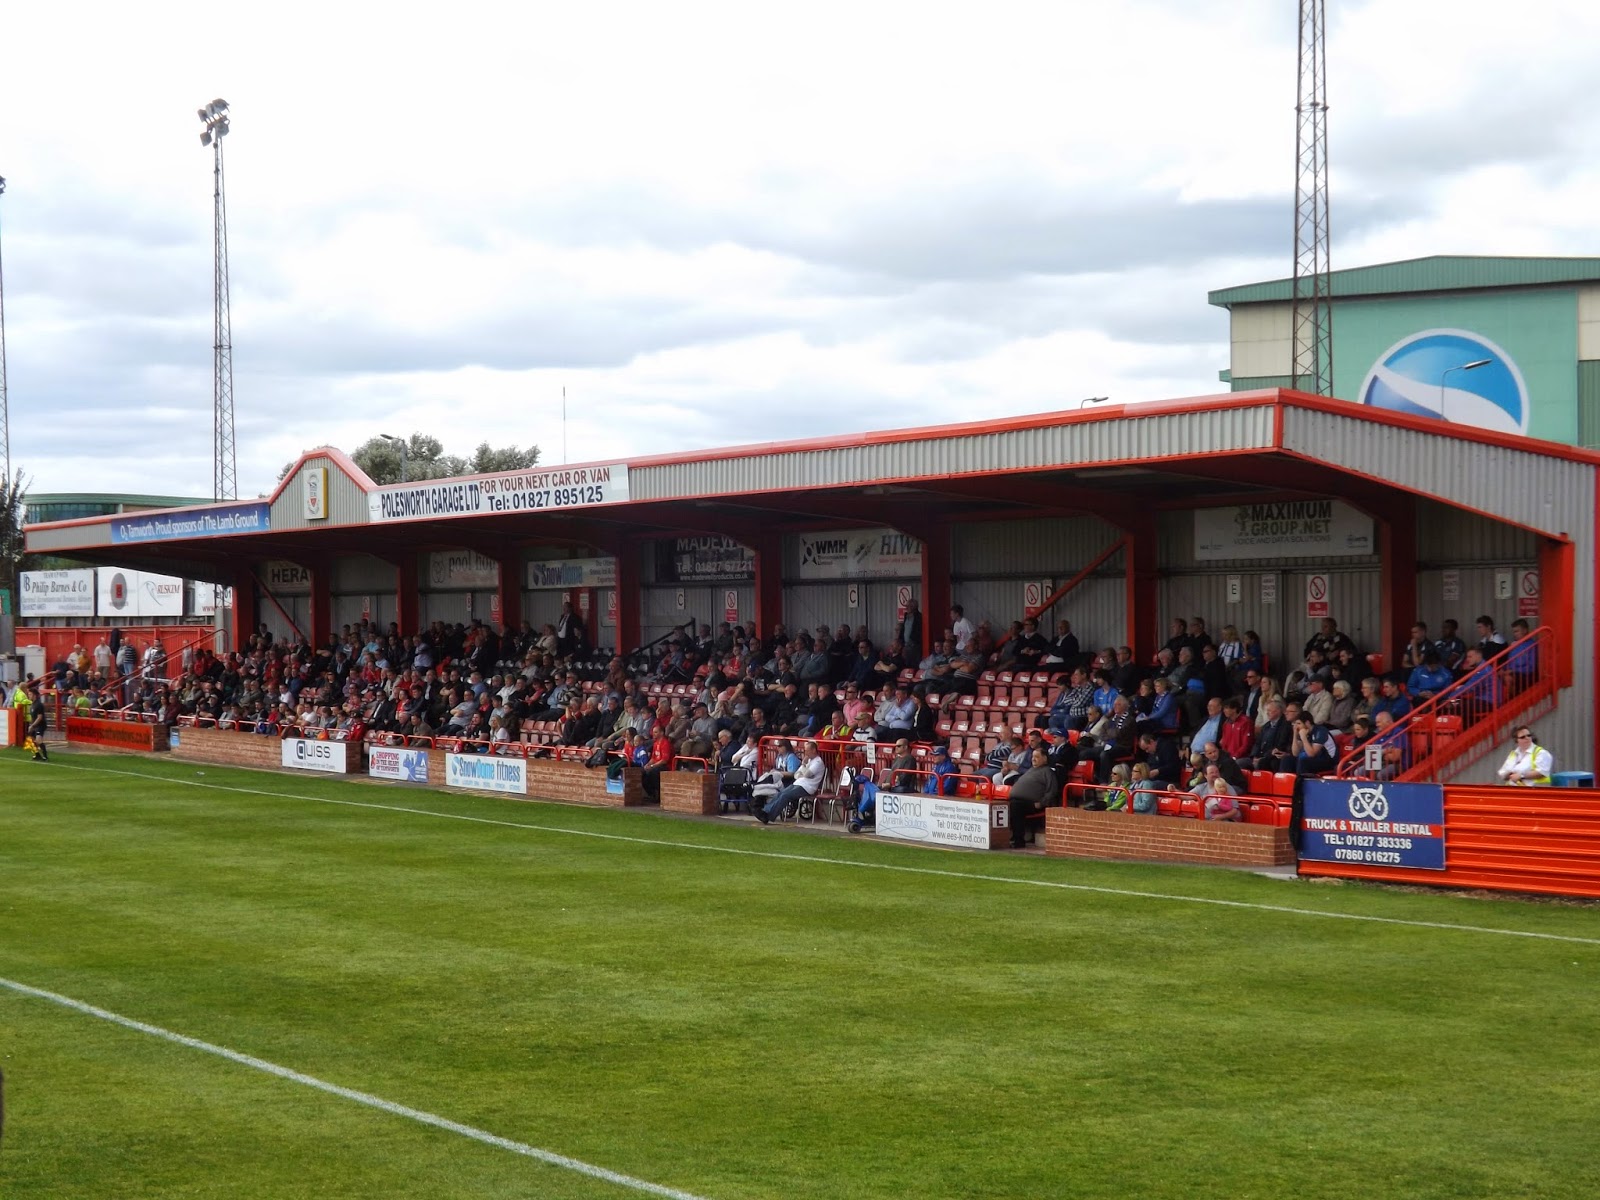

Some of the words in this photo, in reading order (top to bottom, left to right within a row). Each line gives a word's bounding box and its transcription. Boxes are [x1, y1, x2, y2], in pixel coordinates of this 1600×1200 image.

[480, 480, 496, 494] FOR
[498, 477, 524, 492] YOUR
[526, 474, 550, 490] NEXT
[552, 472, 570, 487] CAR
[573, 470, 587, 484] OR
[590, 467, 610, 483] VAN
[381, 488, 430, 518] POLESWORTH
[432, 485, 464, 514] GARAGE
[464, 484, 480, 510] LTD
[488, 494, 510, 511] Tel:
[512, 490, 550, 510] 01827
[554, 486, 603, 504] 895125
[1252, 501, 1332, 521] MAXIMUM
[156, 519, 172, 535] Proud
[172, 521, 198, 536] sponsors
[198, 516, 204, 530] of
[205, 516, 216, 529] The
[217, 514, 233, 530] Lamb
[234, 510, 259, 528] Ground
[1251, 519, 1331, 536] GROUP.NET
[816, 540, 848, 554] WMH
[1271, 536, 1289, 544] DATA
[449, 550, 471, 578] pool
[676, 562, 692, 573] Tel:
[50, 581, 70, 592] Barnes
[72, 581, 76, 592] &
[78, 580, 87, 592] Co
[1232, 584, 1236, 594] E
[1500, 580, 1506, 596] F
[678, 593, 684, 606] C
[849, 590, 857, 604] C
[376, 751, 399, 762] SHOPPING
[1369, 751, 1378, 769] F
[459, 756, 494, 780] SnowDome
[496, 759, 520, 783] fitness
[934, 804, 956, 814] Engineering
[956, 806, 971, 814] Services
[904, 816, 928, 828] Solutions
[930, 811, 949, 819] Automotive
[956, 814, 970, 822] Railway
[996, 810, 1004, 826] E
[946, 820, 963, 831] 01827
[964, 822, 981, 832] 62678
[1305, 818, 1337, 830] TRUCK
[1340, 820, 1347, 830] &
[1349, 821, 1390, 833] TRAILER
[1392, 823, 1432, 835] RENTAL
[932, 830, 986, 844] www.ees-kmd.com
[1324, 834, 1344, 845] TEL:
[1346, 835, 1374, 846] 01827
[1377, 837, 1412, 849] 383336
[1335, 849, 1363, 860] 07860
[1365, 851, 1400, 863] 616275
